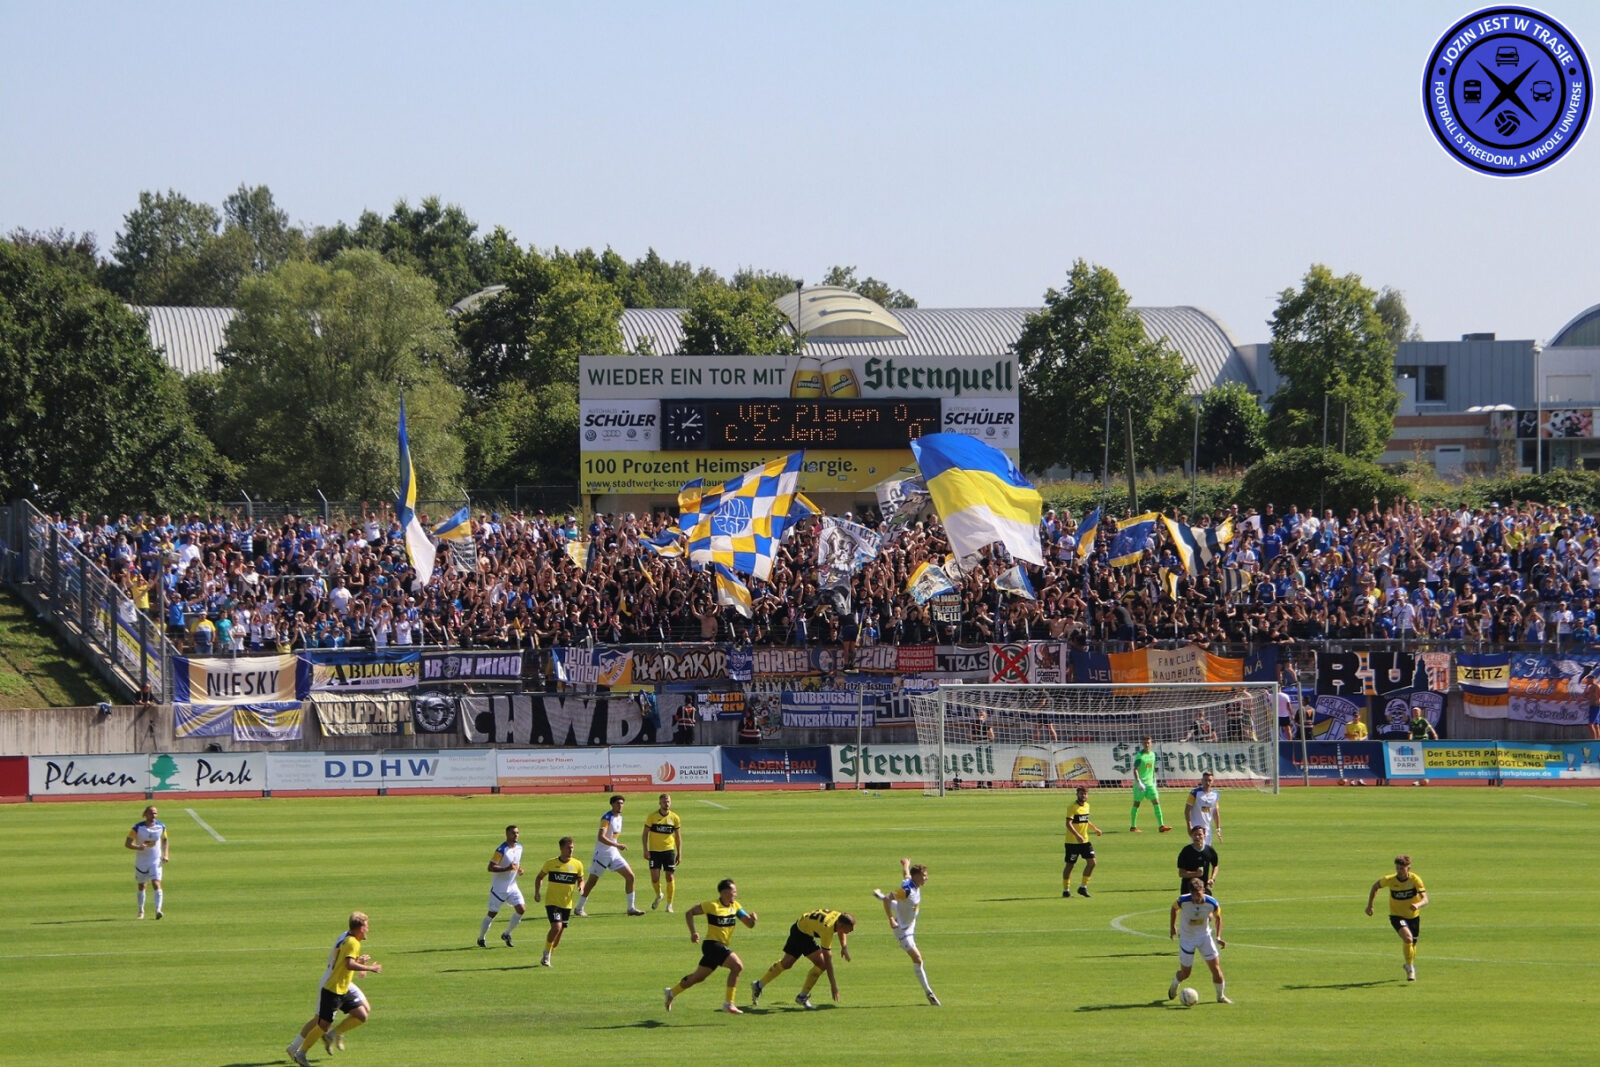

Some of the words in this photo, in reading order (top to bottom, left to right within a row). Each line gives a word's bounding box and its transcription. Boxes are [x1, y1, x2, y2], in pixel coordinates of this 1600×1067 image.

[588, 368, 664, 385] WIEDER
[671, 368, 702, 385] EIN
[709, 368, 746, 385] TOR
[753, 368, 786, 385] MIT
[863, 357, 1015, 397] Sternquell
[584, 410, 656, 427] SCHÜLER
[738, 404, 781, 422] VFC
[796, 404, 879, 422] Plauen
[944, 408, 1015, 425] SCHÜLER
[908, 423, 922, 441] 0
[585, 459, 616, 474] 100
[623, 458, 689, 474] Prozent
[475, 656, 522, 675] MIND
[632, 651, 728, 681] HARAKIR
[935, 652, 990, 671] LTRAS
[1523, 658, 1551, 678] Fan
[1152, 667, 1201, 681] NAUMBURG
[1464, 668, 1502, 679] ZEITZ
[207, 670, 280, 696] NIESKY
[1112, 742, 1267, 774] Srnquell
[1344, 754, 1369, 764] BAU
[1427, 750, 1443, 758] Der
[1445, 750, 1481, 758] ELSTER
[1484, 750, 1510, 758] PARK
[1428, 759, 1444, 767] den
[1446, 759, 1475, 767] SPORT
[1478, 759, 1489, 767] im
[324, 758, 440, 778] DDHW
[791, 760, 817, 769] BAU
[45, 761, 137, 790] Plauen
[196, 759, 252, 786] Park
